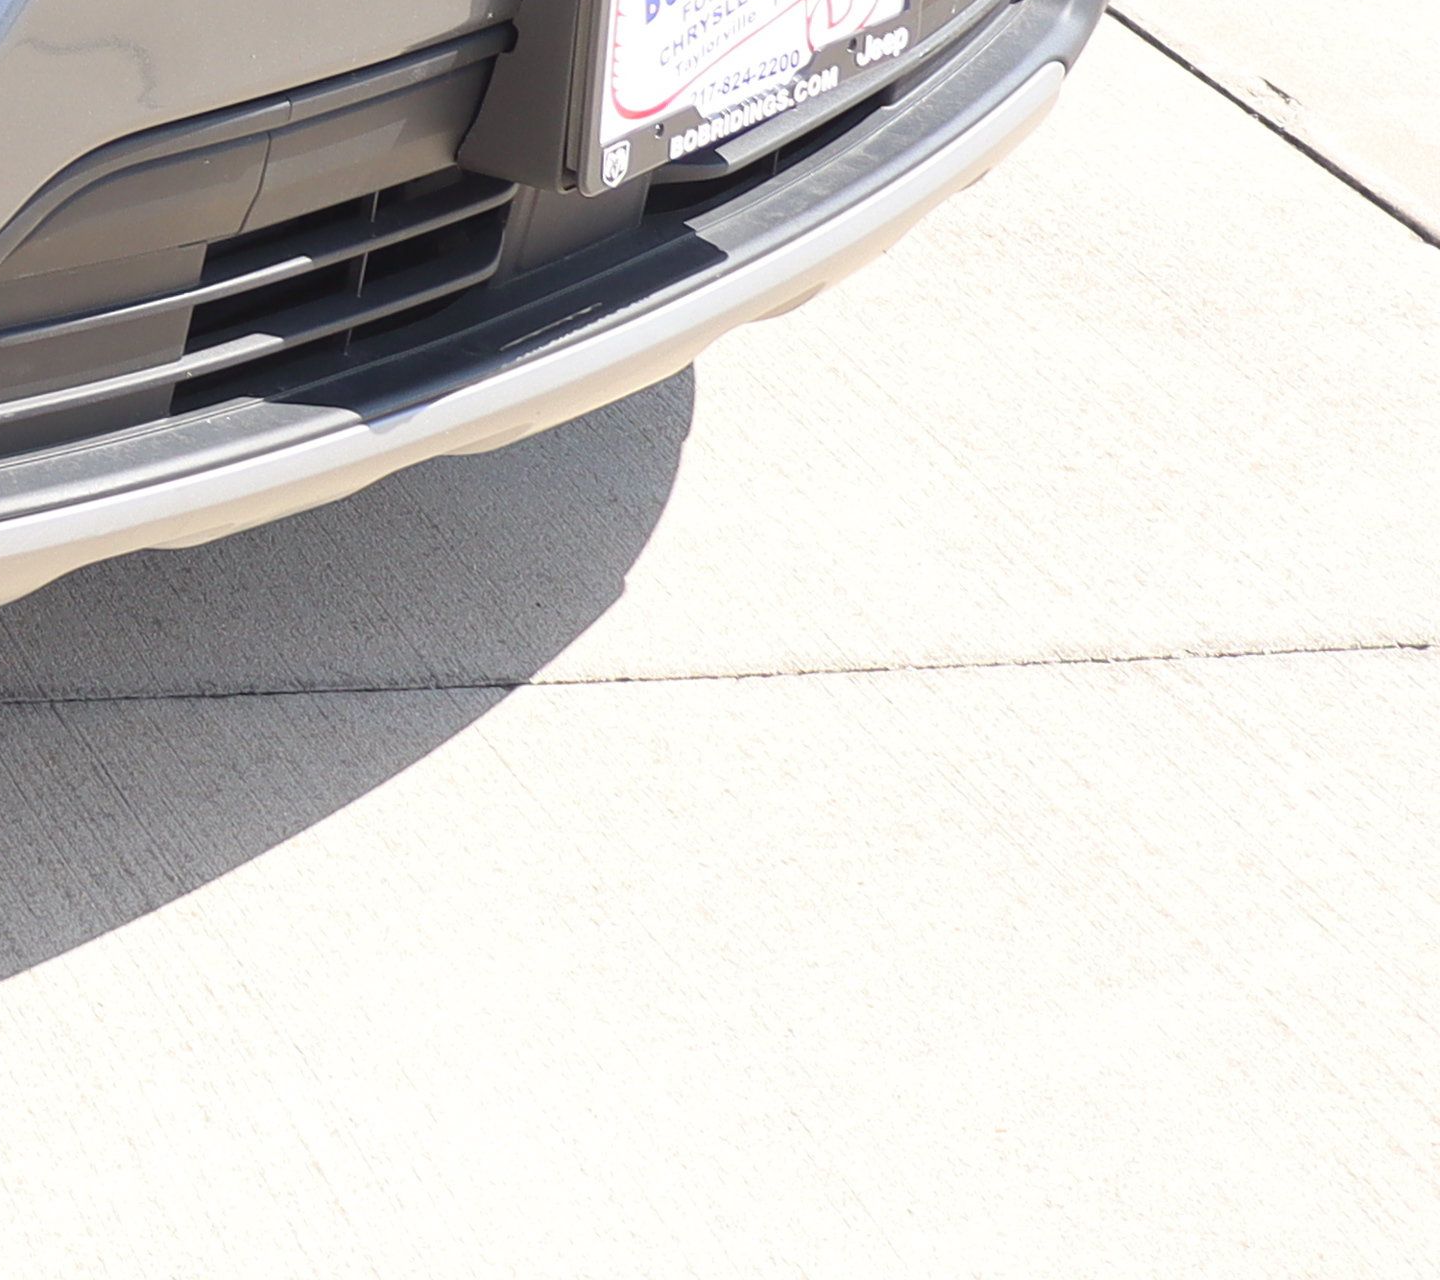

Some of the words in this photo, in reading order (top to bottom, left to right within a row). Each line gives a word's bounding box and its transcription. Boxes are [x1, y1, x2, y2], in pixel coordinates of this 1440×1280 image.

[856, 26, 909, 66] Jeep
[691, 49, 800, 107] 217-824-2200
[668, 65, 840, 161] BOBRIDINGS.COM
